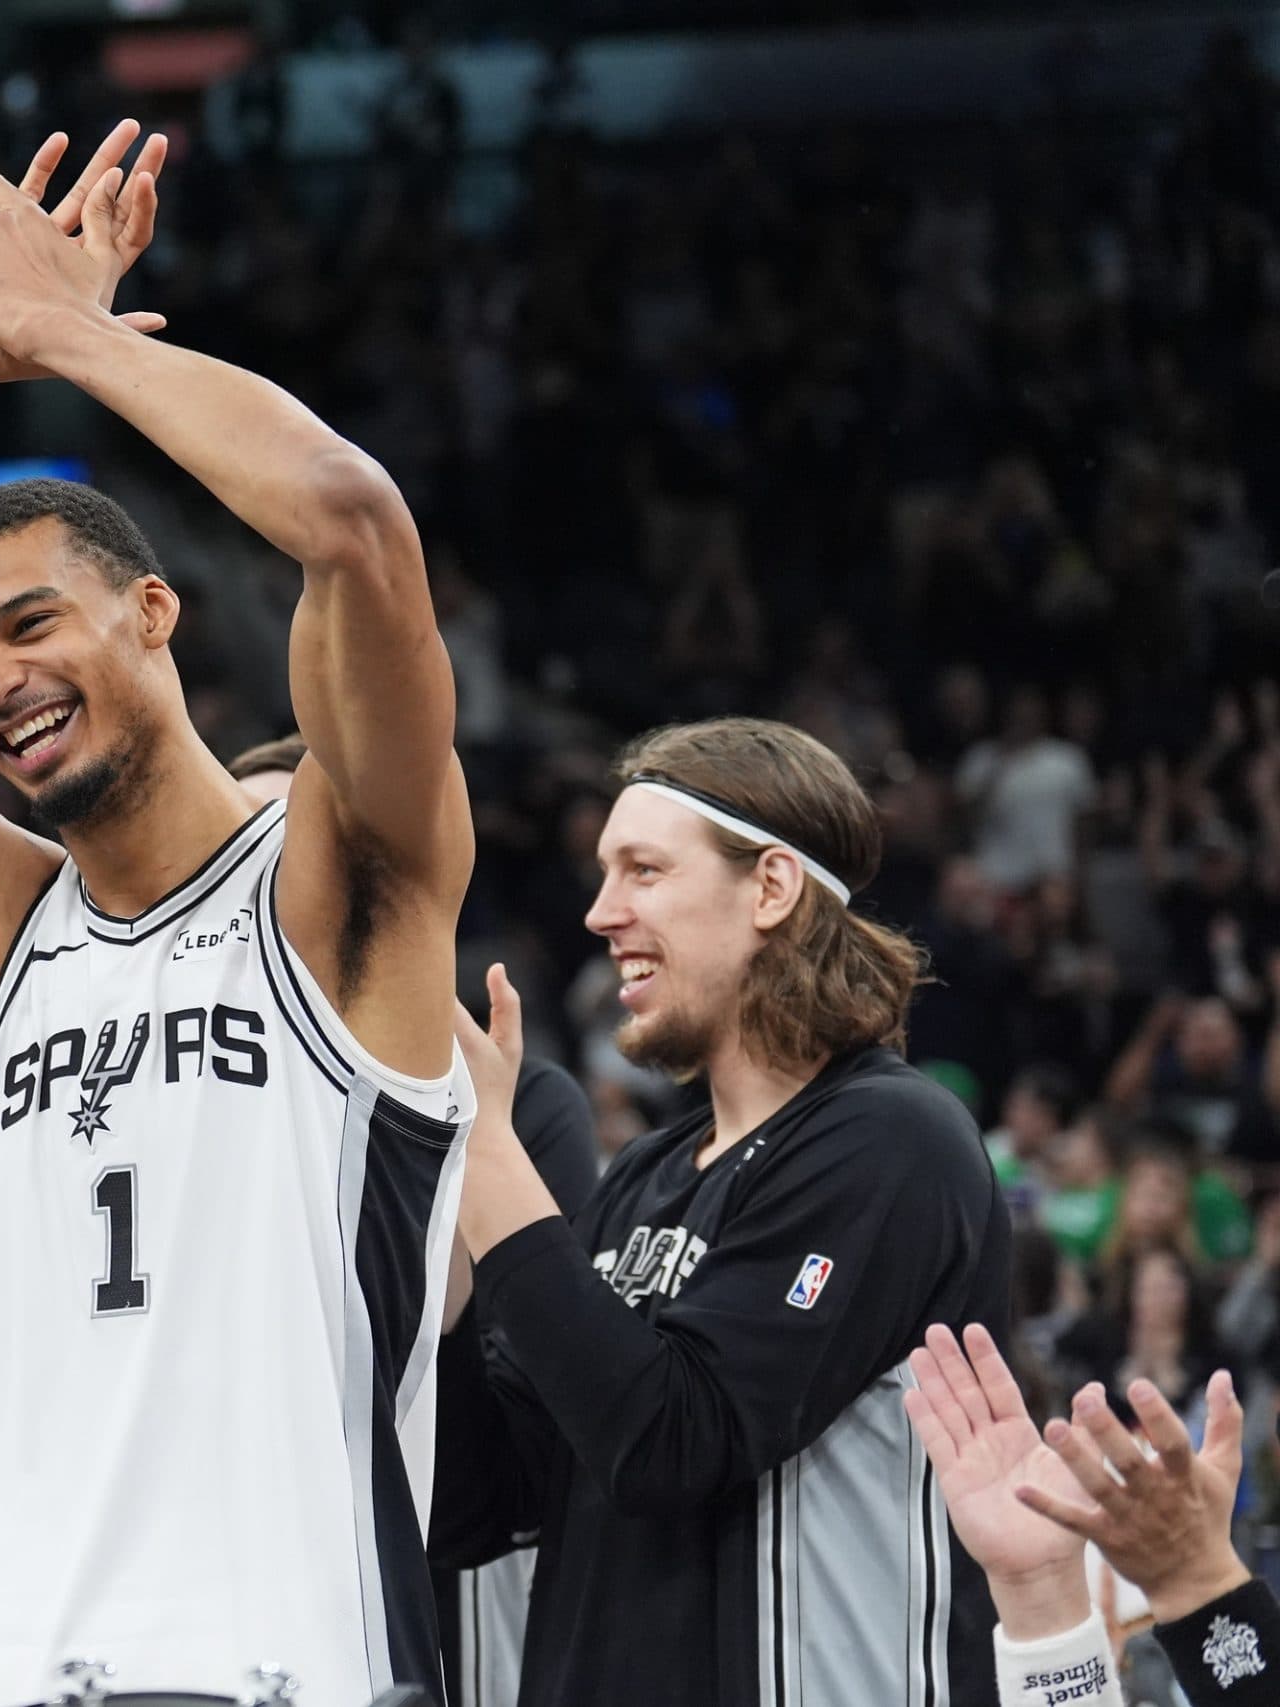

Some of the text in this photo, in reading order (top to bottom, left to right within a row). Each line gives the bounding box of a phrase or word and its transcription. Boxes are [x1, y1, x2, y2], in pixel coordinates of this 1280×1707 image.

[186, 918, 239, 949] LEDR
[1, 1003, 268, 1146] SPURS
[91, 1163, 151, 1319] 1
[1024, 1656, 1098, 1690] fitness
[1045, 1664, 1107, 1707] planet
